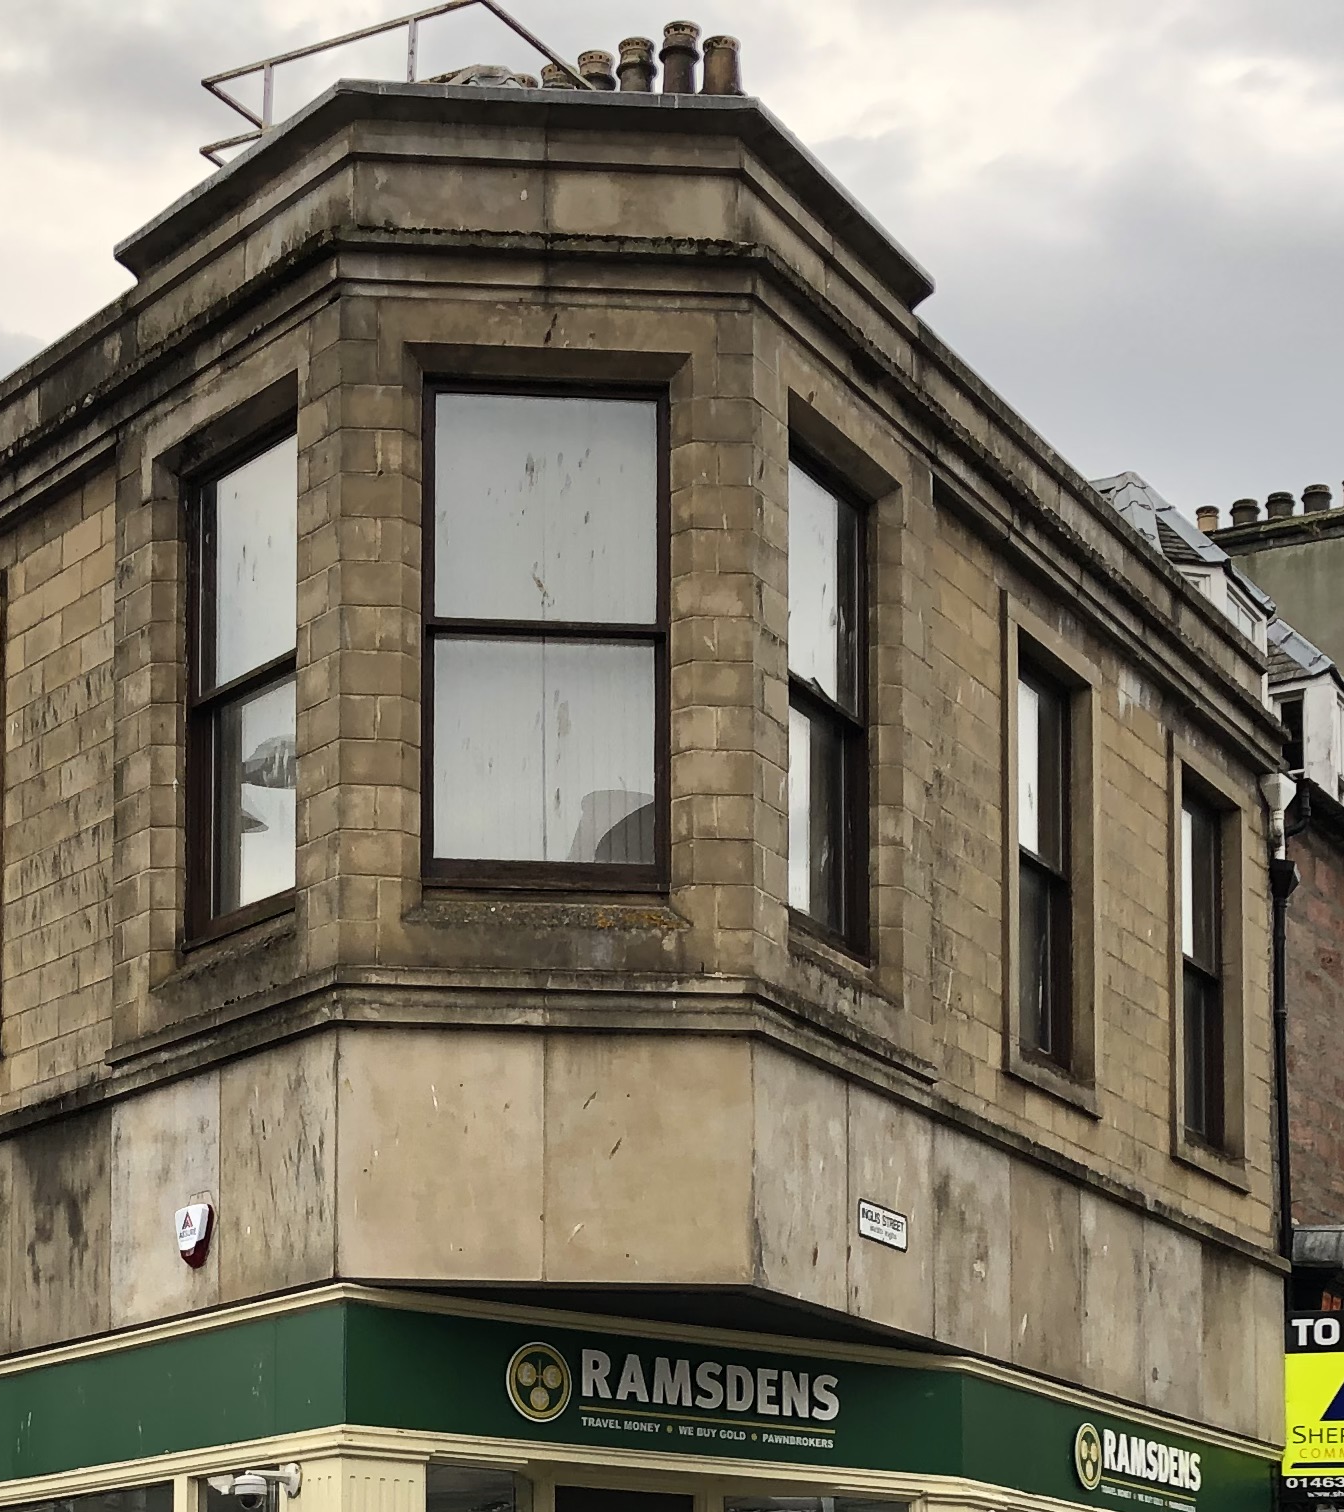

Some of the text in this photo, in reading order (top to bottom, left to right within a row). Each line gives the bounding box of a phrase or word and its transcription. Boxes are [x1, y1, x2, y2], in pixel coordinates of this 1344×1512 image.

[882, 1214, 904, 1232] STREET
[1291, 1317, 1341, 1347] TO
[580, 1348, 840, 1421] RAMSDENS
[580, 1416, 834, 1449] TRAVEL MONEY WE BUY GOLD PAWNBROKERS
[1103, 1428, 1202, 1491] RAMSDENS
